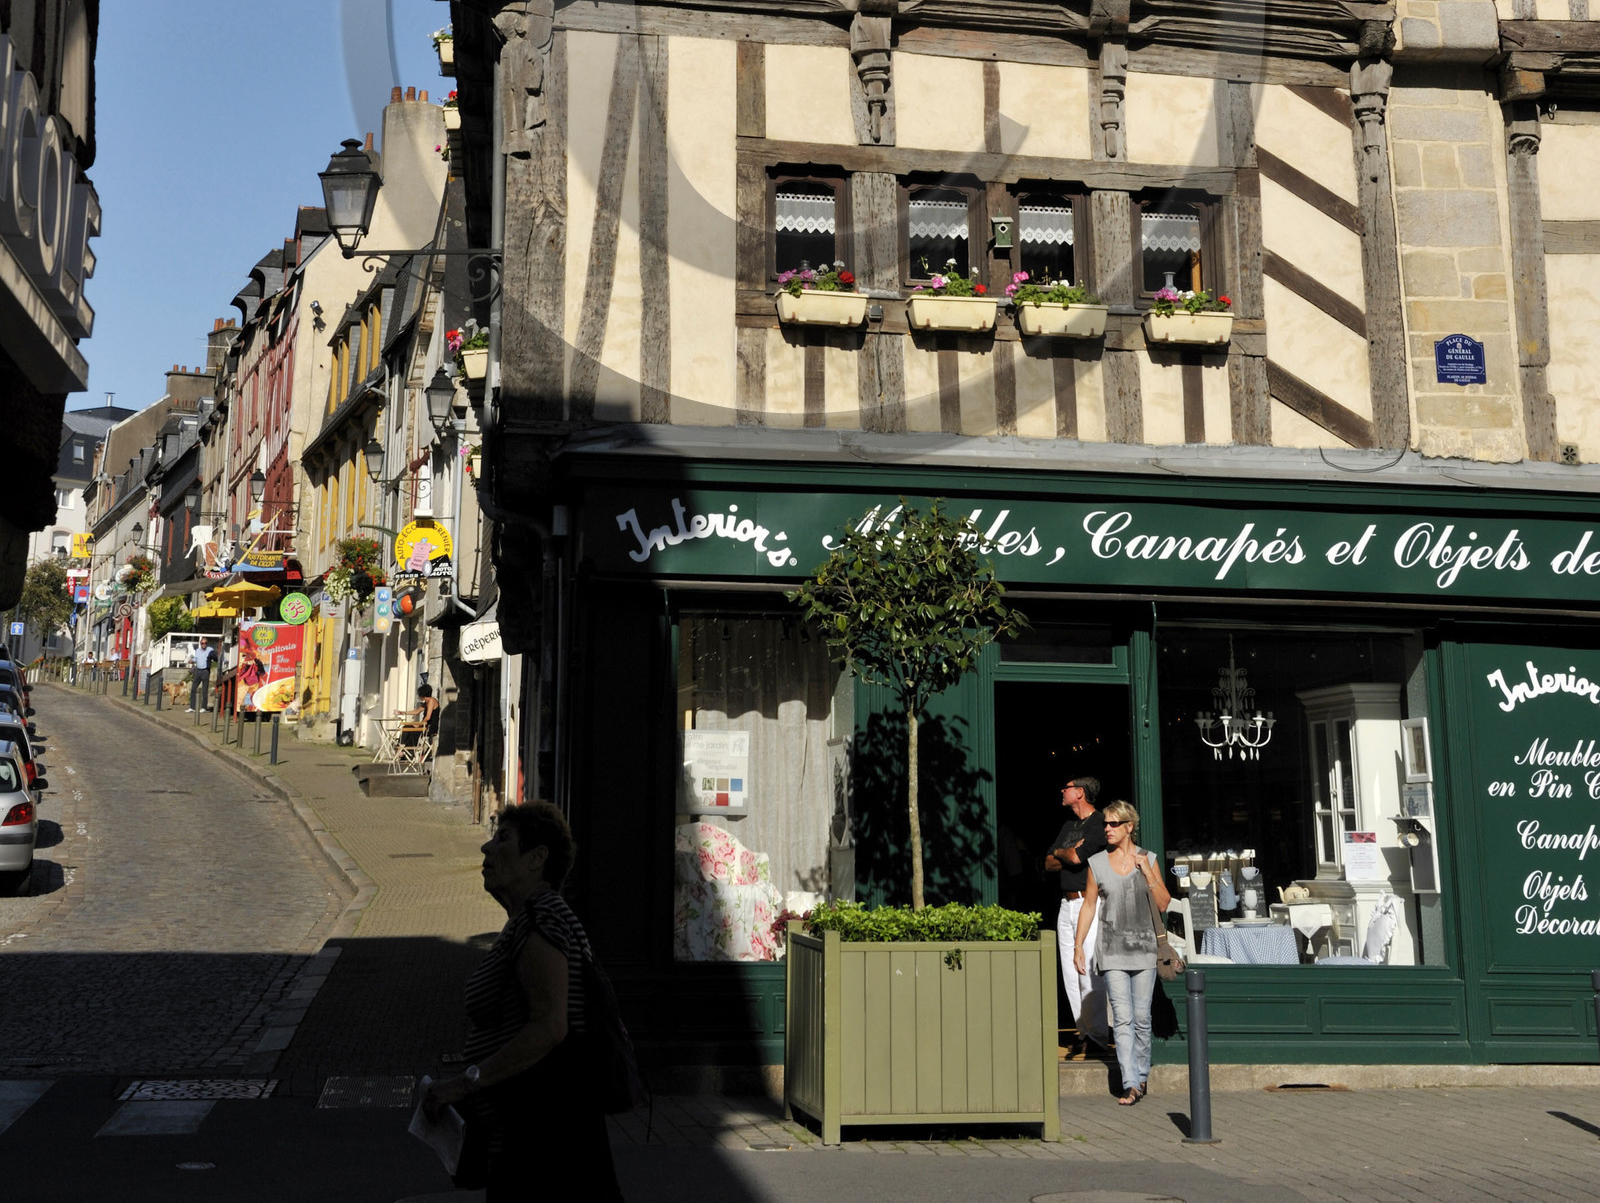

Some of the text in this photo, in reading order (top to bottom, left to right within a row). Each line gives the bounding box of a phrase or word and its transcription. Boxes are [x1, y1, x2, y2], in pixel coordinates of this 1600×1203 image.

[1446, 338, 1462, 346] PLACE
[616, 497, 791, 567] Interior's
[1082, 510, 1305, 580] Canapés
[1325, 524, 1377, 566] et
[1393, 522, 1531, 589] Objets
[1550, 531, 1600, 575] de
[1487, 780, 1515, 797] en
[1528, 769, 1573, 798] Pin
[1522, 870, 1588, 912] Objets
